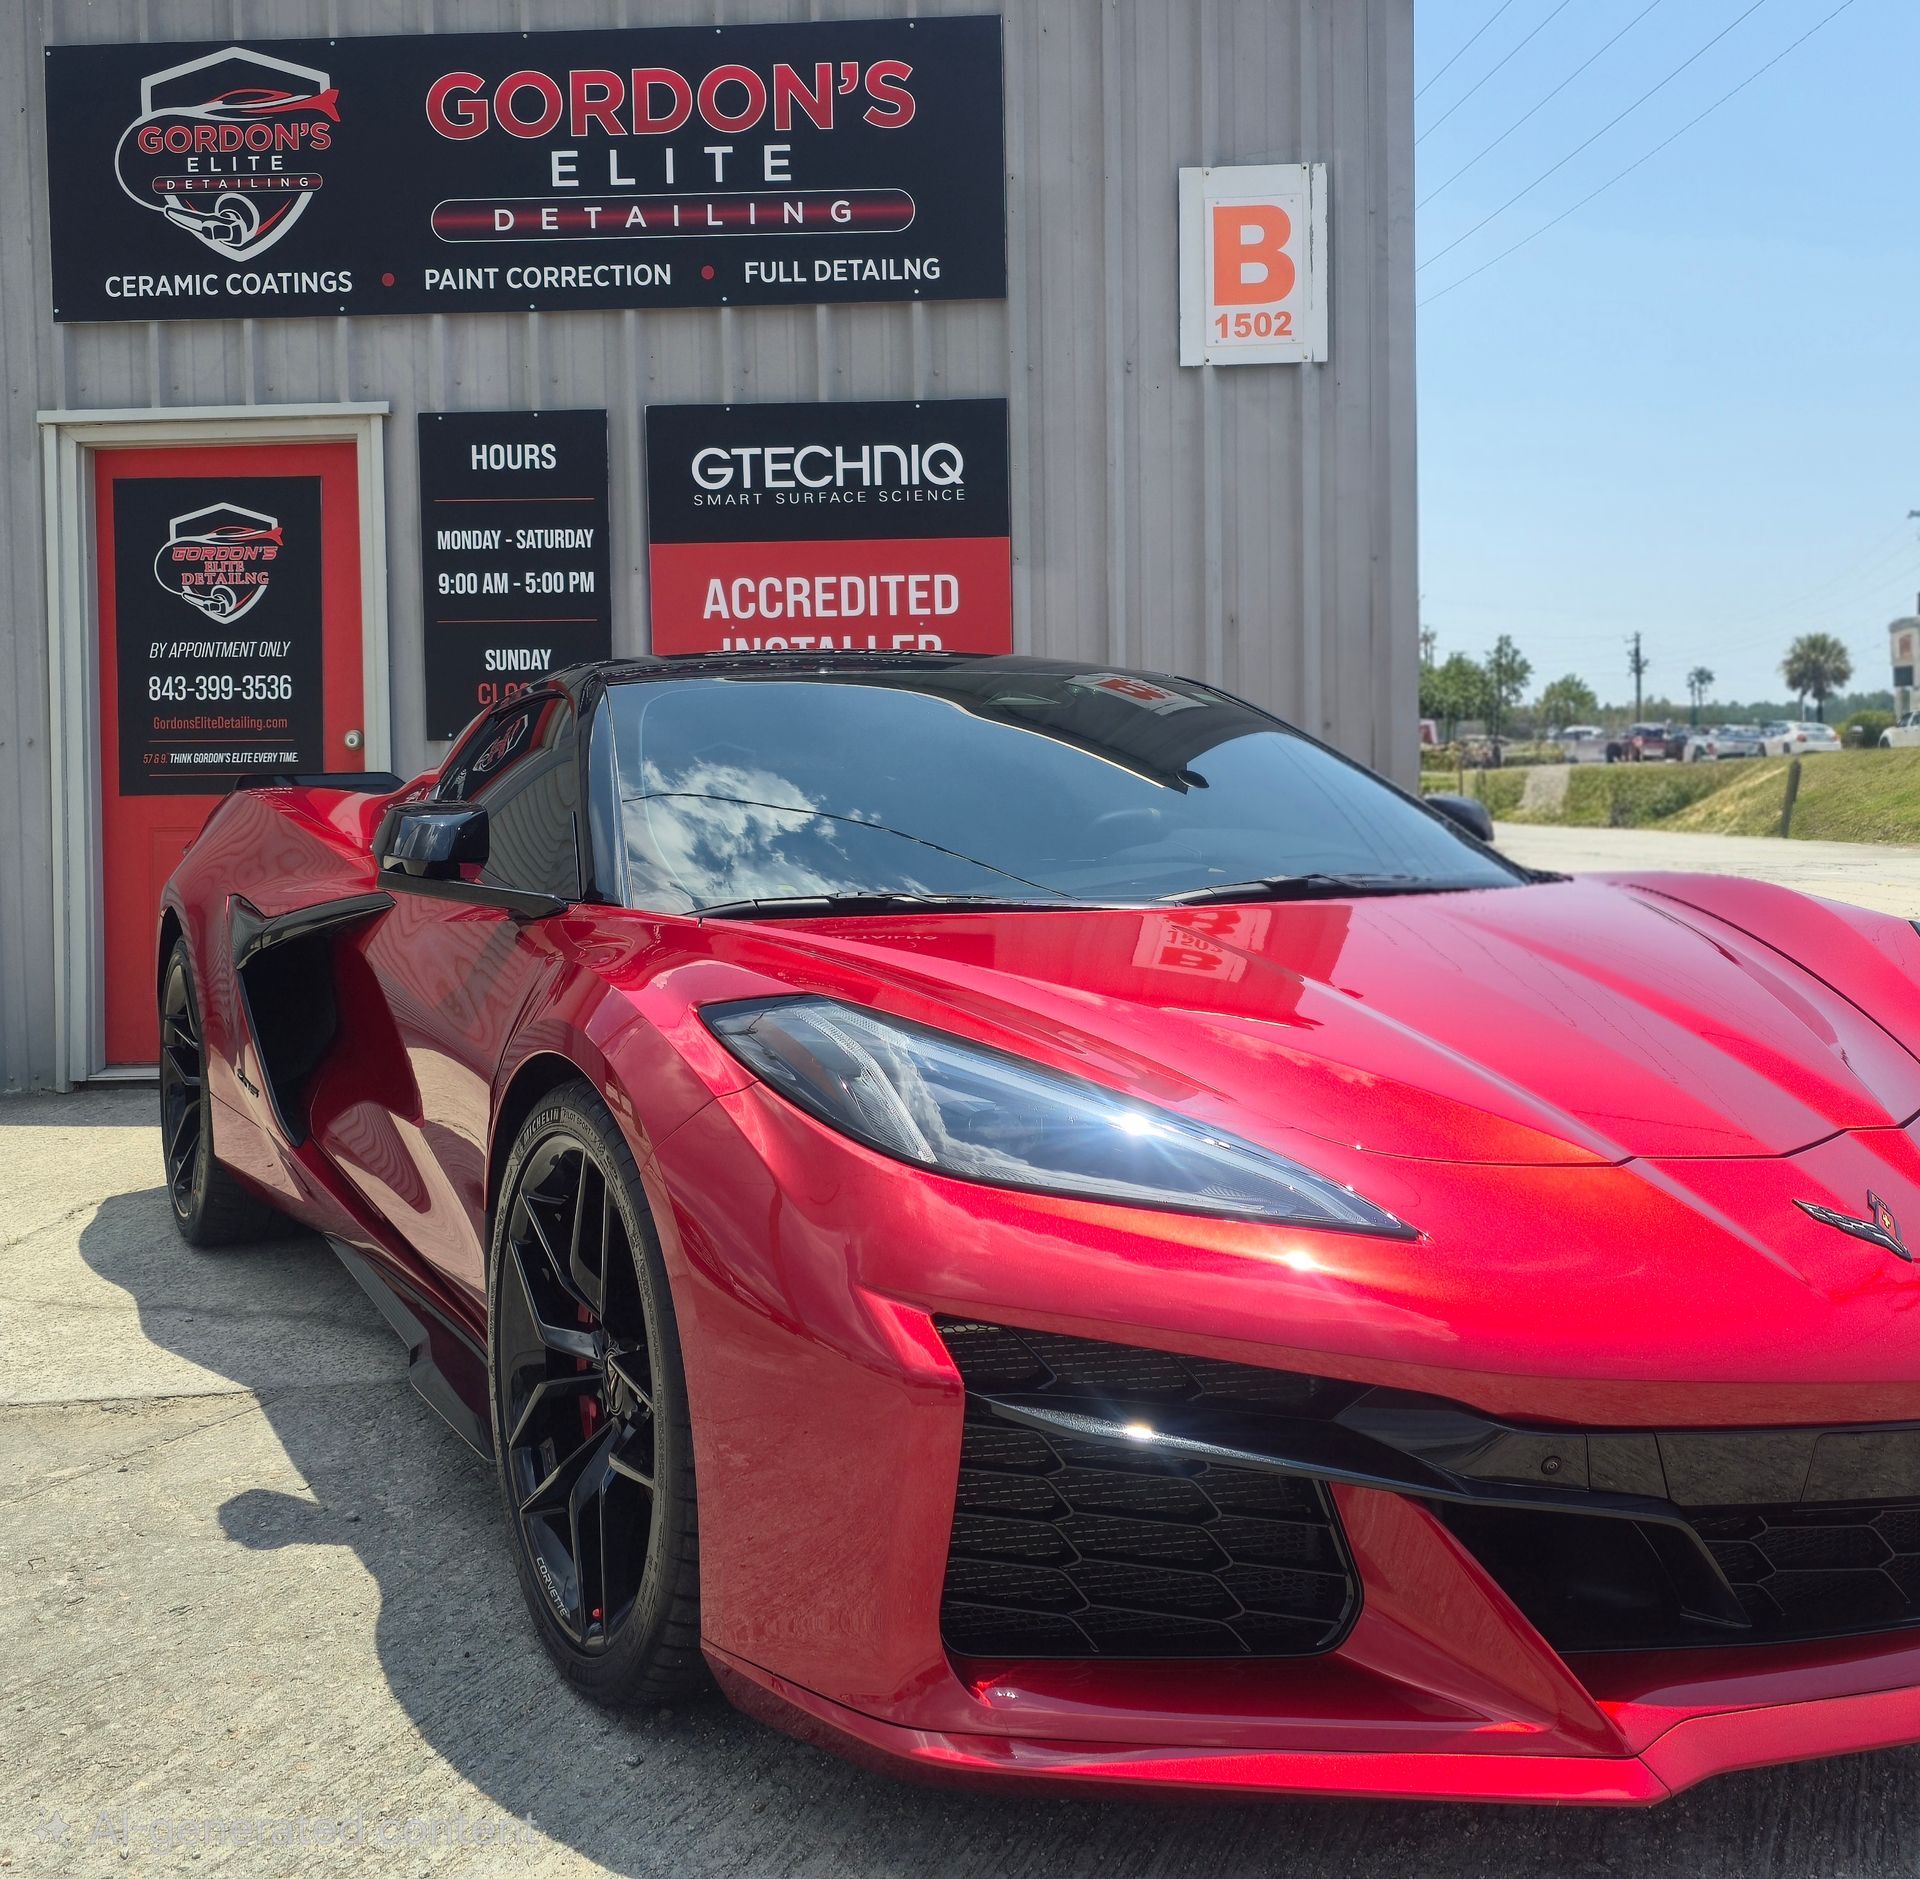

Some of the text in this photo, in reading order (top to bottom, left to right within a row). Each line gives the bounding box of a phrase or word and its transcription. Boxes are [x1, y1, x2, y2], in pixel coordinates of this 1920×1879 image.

[426, 60, 915, 140] GORDON'S
[137, 122, 332, 154] GORDON'S
[188, 156, 283, 172] ELITE
[552, 145, 791, 186] ELITE
[166, 177, 310, 190] DETAILING
[493, 200, 852, 231] DETAILING
[1214, 205, 1295, 306] B
[426, 264, 670, 290] PAINT CORRECTION
[745, 258, 940, 283] FULL DETAILNG
[106, 271, 352, 297] CERAMIC COATINGS
[1216, 311, 1292, 338] 1502
[472, 444, 556, 469] HOURS
[692, 443, 964, 490] GTECHNIQ
[694, 489, 964, 505] SMART SURFACE SCIENCE
[438, 530, 501, 549] MONDAY
[516, 529, 593, 549] SATURDAY
[172, 546, 278, 561] GORDON'S
[204, 561, 244, 572] ELITE
[439, 573, 477, 594] 9:00
[483, 573, 508, 593] AM
[526, 572, 564, 593] 5:00
[569, 572, 594, 592] PM
[704, 574, 958, 619] ACCREDITED
[150, 641, 291, 658] BY APPOINTMENT ONLY
[485, 649, 551, 670] SUNDAY
[149, 675, 291, 700] 843-399-3536
[154, 716, 287, 730] GordonsEliteDetailing.com
[170, 753, 192, 763] THINK
[194, 753, 231, 763] GORDON'S
[232, 753, 252, 762] ELITE
[254, 753, 278, 762] EVERY
[279, 752, 298, 762] TIME.
[523, 1108, 560, 1145] MICHELIN
[536, 1556, 568, 1617] CORVETTE
